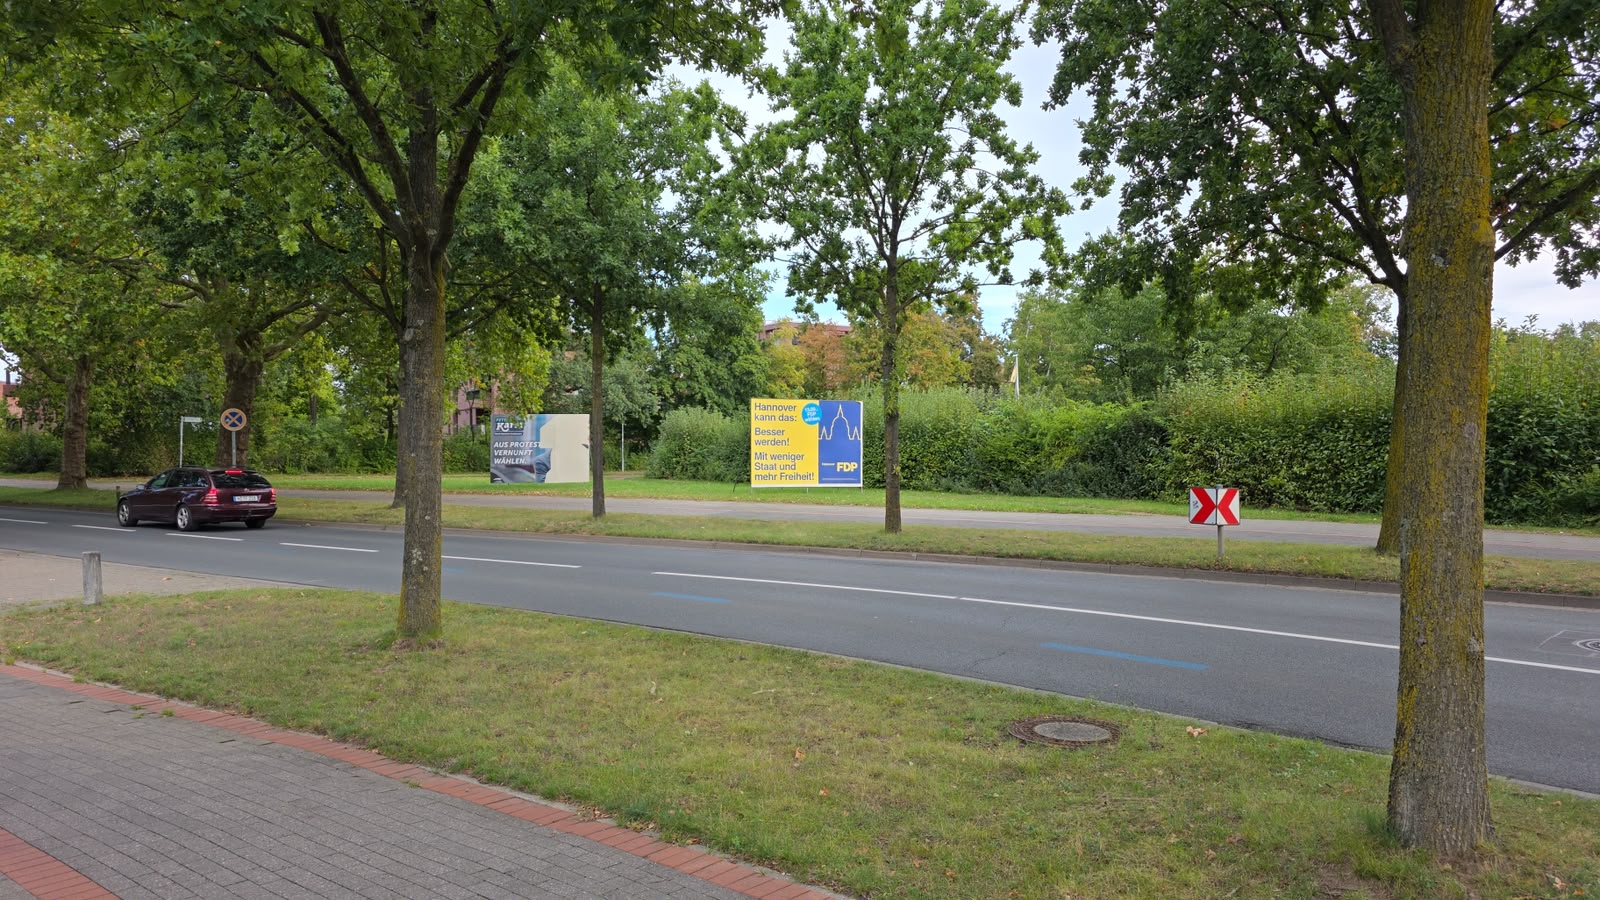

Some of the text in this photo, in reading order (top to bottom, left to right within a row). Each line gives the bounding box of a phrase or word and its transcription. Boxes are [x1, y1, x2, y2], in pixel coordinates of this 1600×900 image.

[754, 403, 797, 411] Hannover
[754, 413, 776, 421] kann
[778, 413, 797, 421] das:
[754, 427, 785, 435] Besser
[754, 438, 790, 446] werden!
[754, 452, 805, 462] Mit weniger
[754, 462, 797, 470] Staat und
[836, 461, 858, 472] FDP
[754, 472, 777, 480] mehr
[779, 472, 815, 480] Freiheit!
